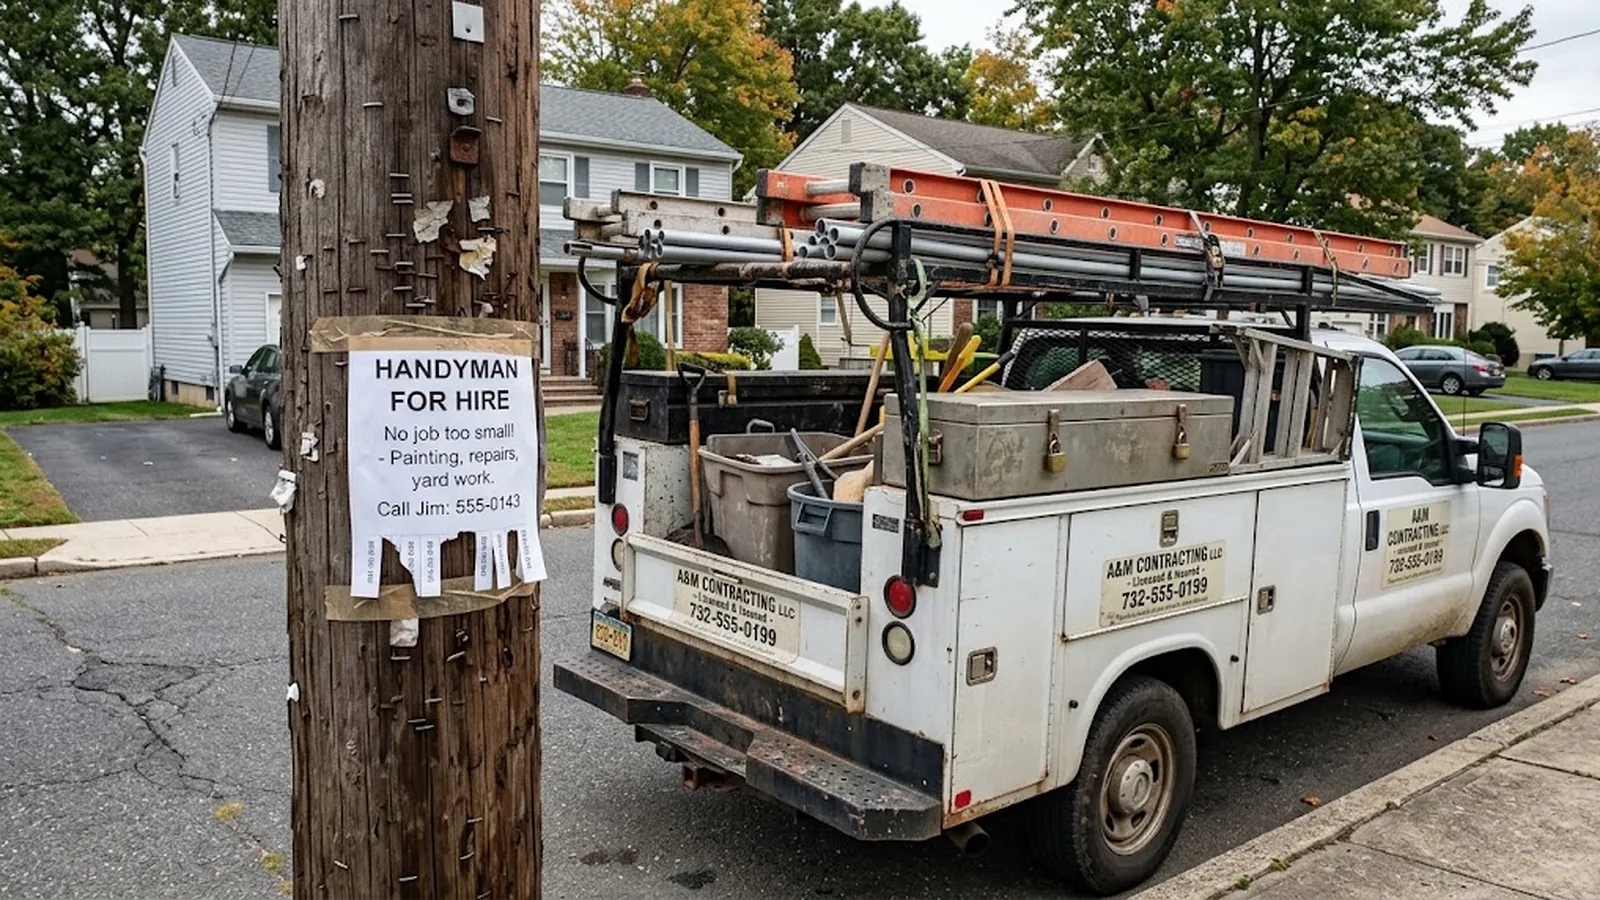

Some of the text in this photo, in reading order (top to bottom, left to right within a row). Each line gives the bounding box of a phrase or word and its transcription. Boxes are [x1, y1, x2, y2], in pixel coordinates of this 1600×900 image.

[376, 359, 518, 379] HANDYMAN
[391, 390, 509, 411] FOR HIRE
[384, 423, 515, 444] No job too small!
[390, 450, 464, 468] Painting,
[469, 447, 519, 466] repairs,
[411, 470, 495, 491] yard work.
[377, 493, 520, 517] Call Jim: 555-0143
[1106, 546, 1224, 580] A&M CONTRACTING LLC
[702, 576, 776, 614] CONTRACTING
[778, 603, 796, 619] LLC
[1122, 577, 1208, 610] 732-555-0199
[690, 602, 777, 647] 732-555-0199
